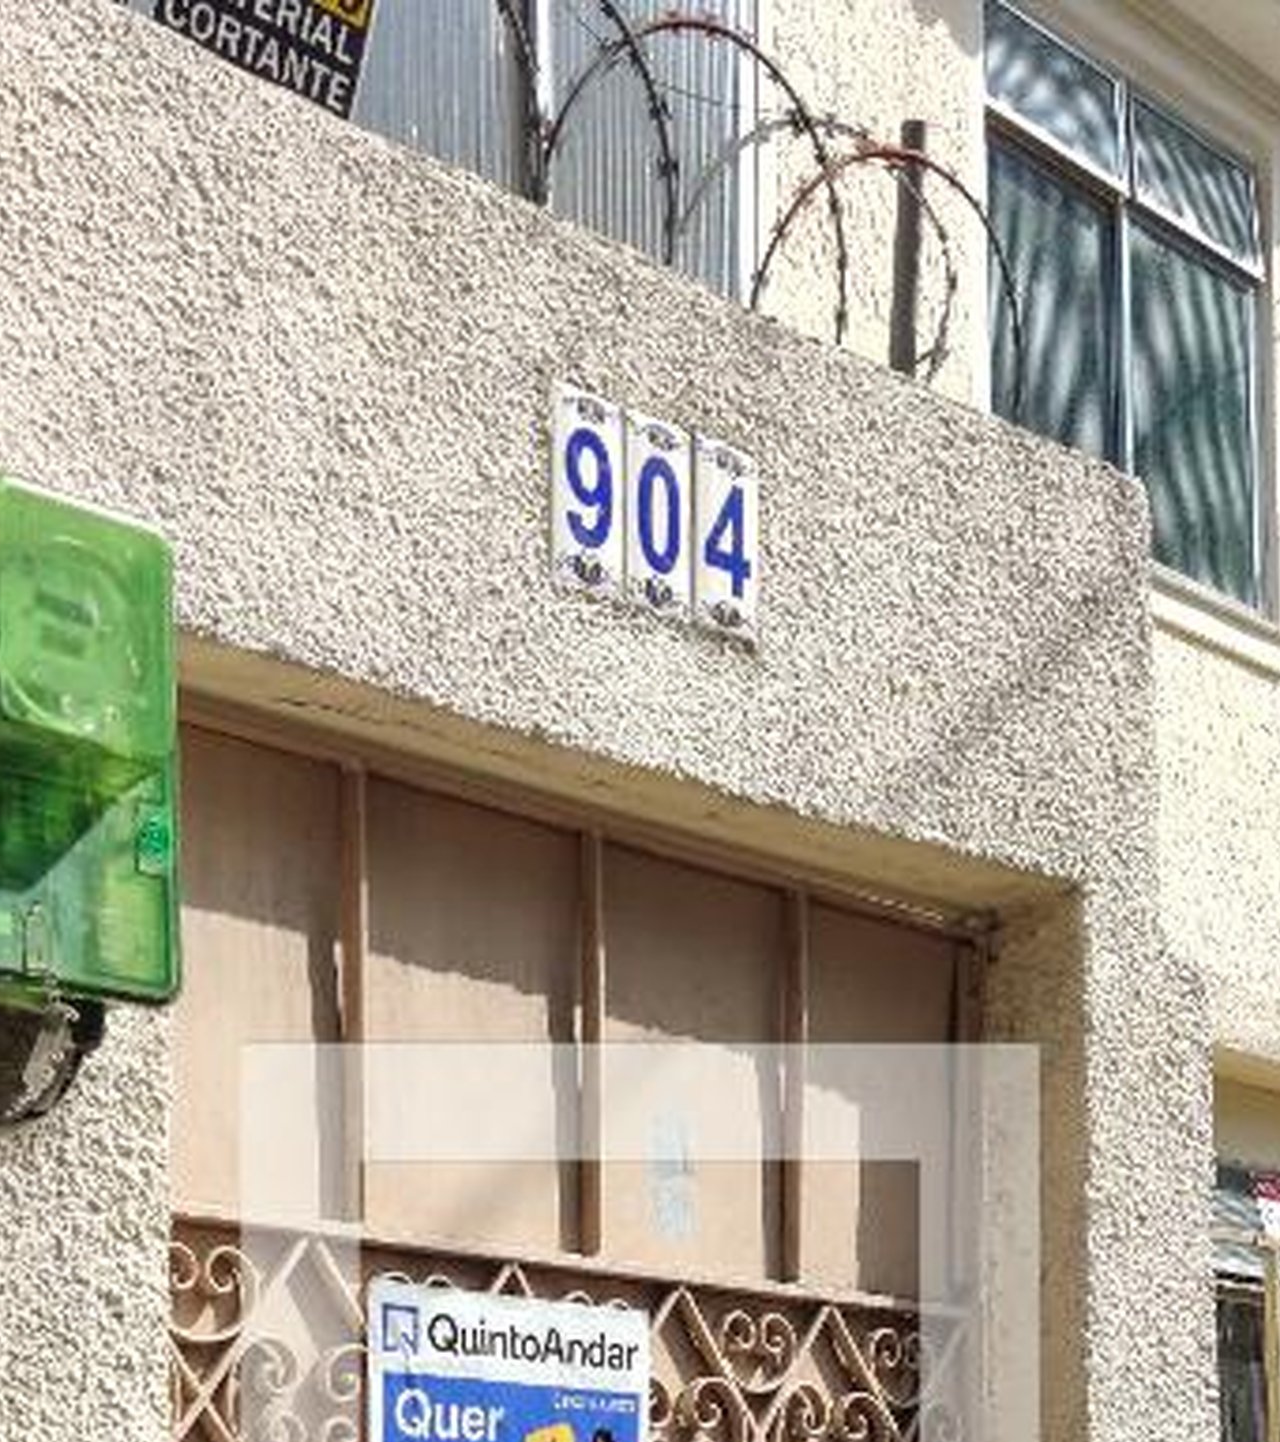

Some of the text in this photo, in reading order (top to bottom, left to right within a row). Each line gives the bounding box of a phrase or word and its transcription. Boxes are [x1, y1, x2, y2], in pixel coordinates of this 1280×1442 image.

[164, 0, 351, 111] CORTANTE
[236, 0, 353, 65] ERIAL
[565, 427, 751, 600] 904
[427, 1313, 640, 1371] QuintoAndar
[394, 1388, 505, 1442] Quer
